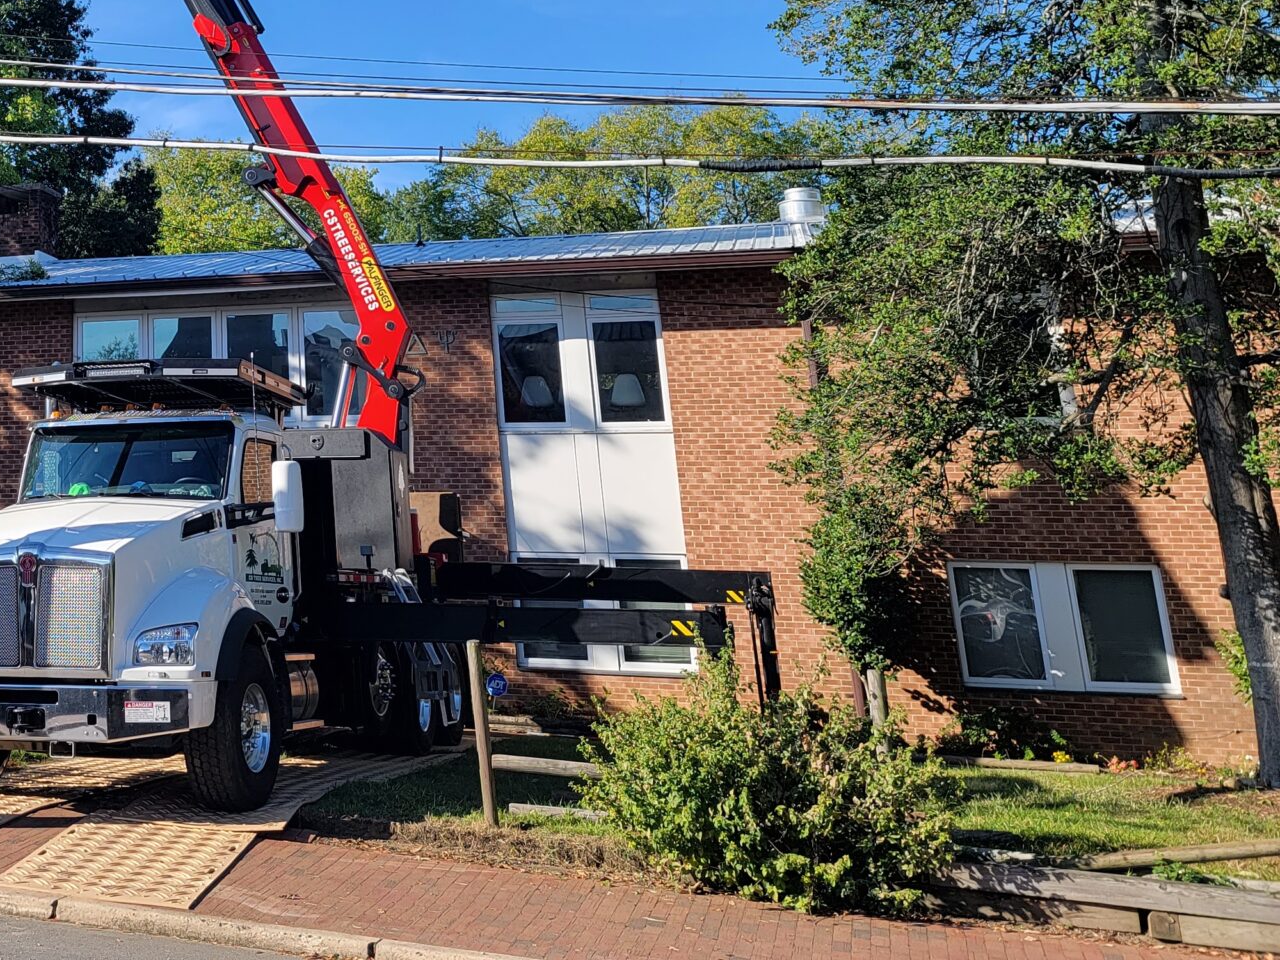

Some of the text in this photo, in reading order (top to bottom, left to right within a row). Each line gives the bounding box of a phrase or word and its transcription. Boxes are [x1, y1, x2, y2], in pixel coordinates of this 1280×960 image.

[343, 210, 369, 256] 65002-SH
[323, 208, 380, 311] CSTREESERVICES
[364, 259, 393, 309] PALFINGER
[489, 679, 504, 689] ADT
